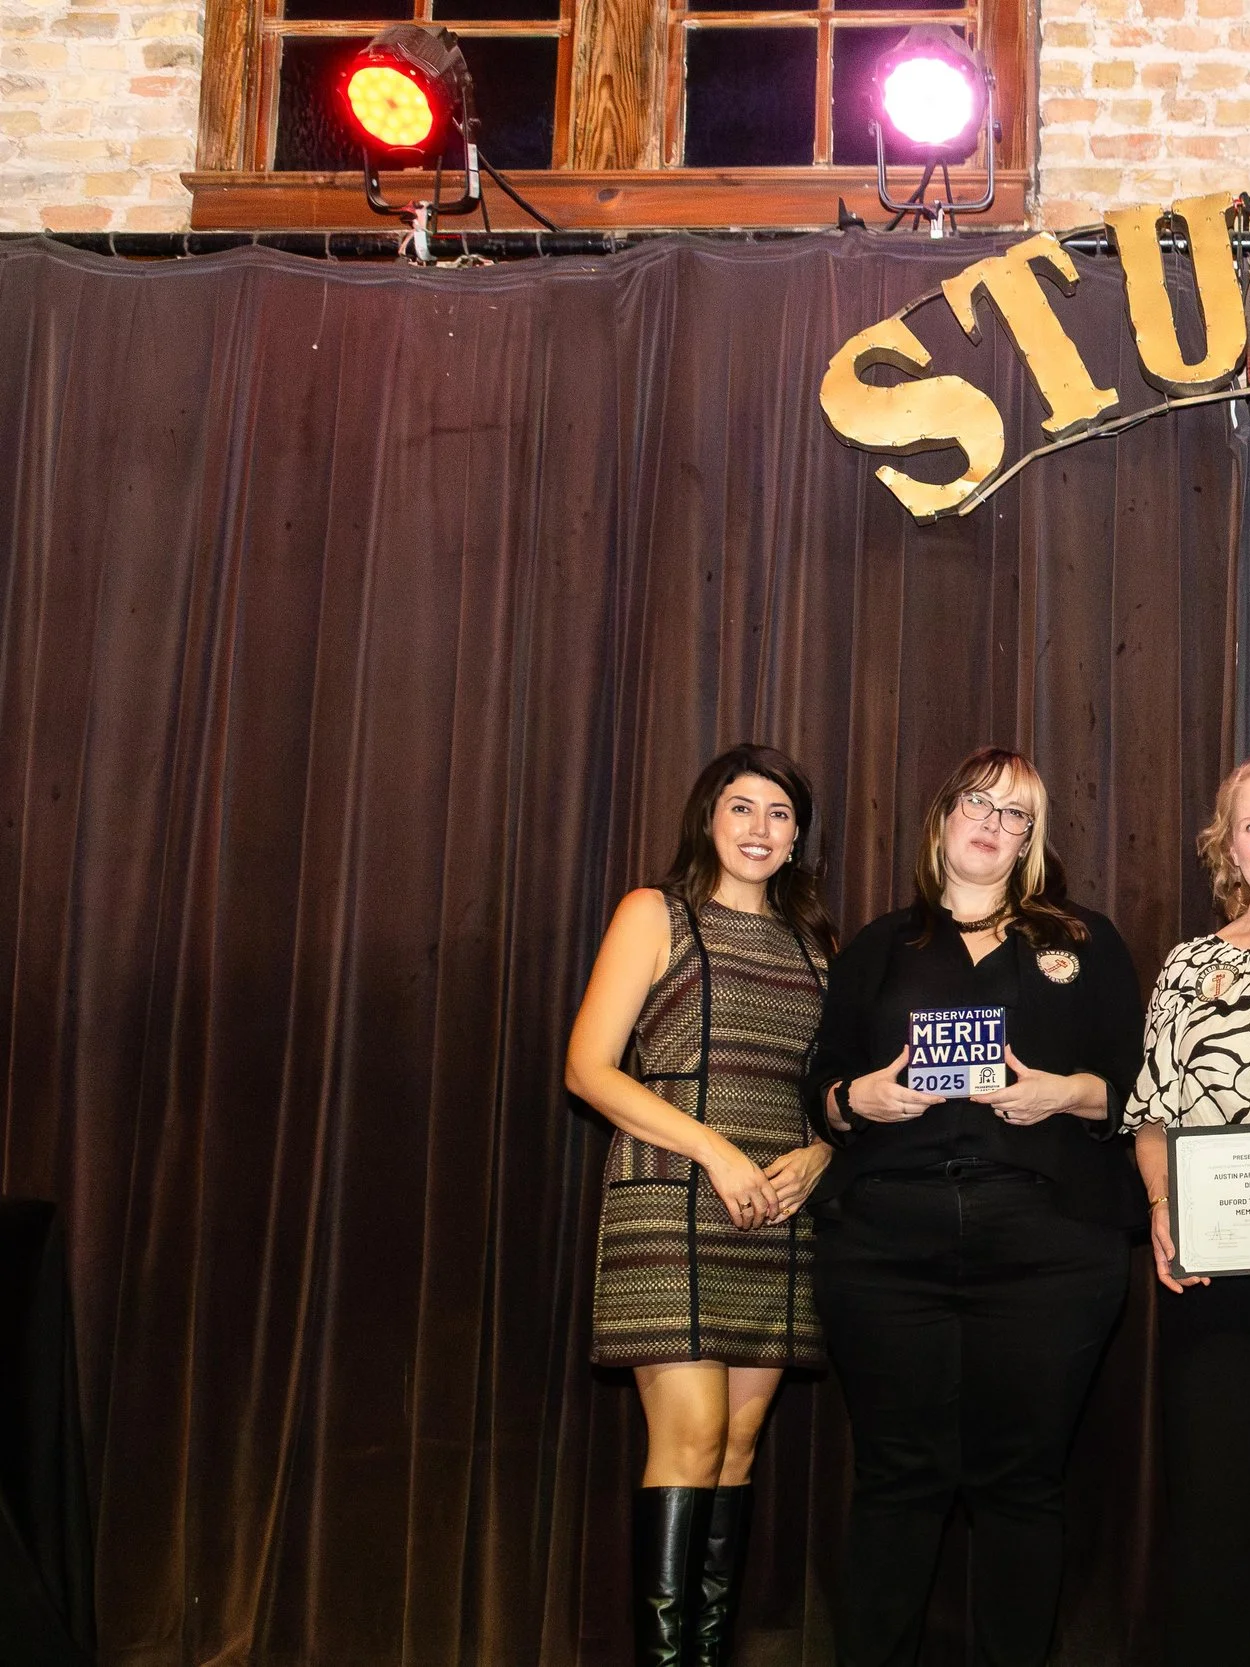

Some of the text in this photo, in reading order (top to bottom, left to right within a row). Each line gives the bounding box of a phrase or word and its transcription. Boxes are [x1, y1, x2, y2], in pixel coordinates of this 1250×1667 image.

[1199, 965, 1217, 983] AWARD
[912, 1009, 1001, 1022] PRESERVATION
[912, 1020, 1001, 1046] MERIT
[911, 1043, 1002, 1065] AWARD
[912, 1074, 965, 1091] 2025
[1219, 1198, 1247, 1206] BUFORD
